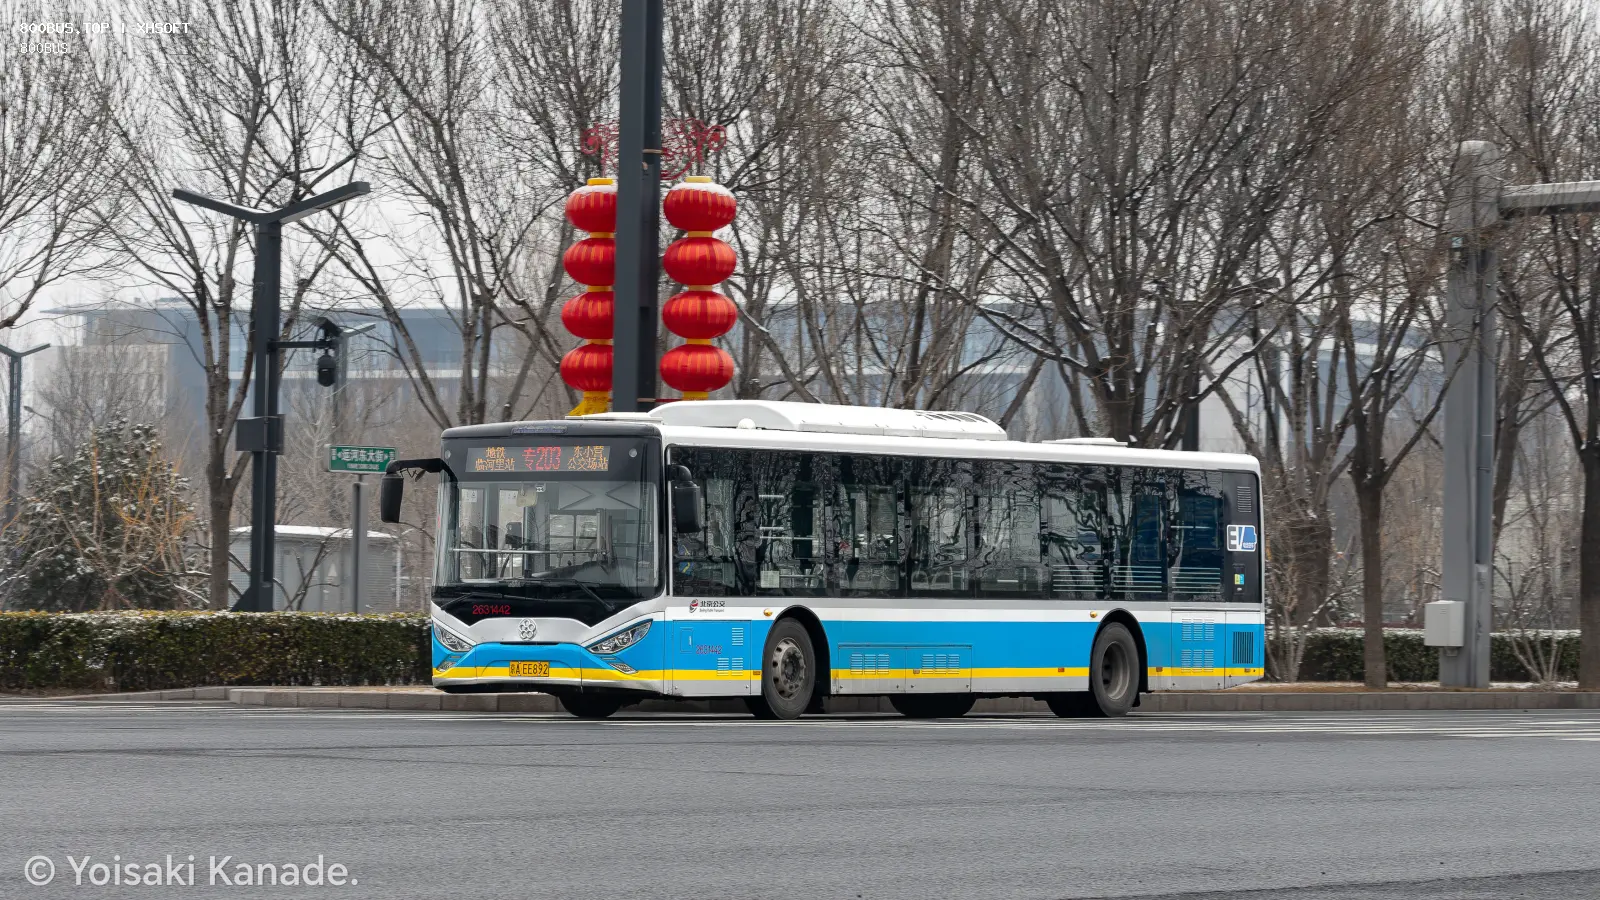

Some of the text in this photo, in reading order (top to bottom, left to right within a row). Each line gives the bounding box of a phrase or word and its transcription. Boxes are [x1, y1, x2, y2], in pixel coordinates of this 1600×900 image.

[341, 448, 384, 463] 运河东大街
[485, 446, 506, 459] 地铁
[573, 445, 604, 458] 东小营
[475, 458, 516, 471] 临河里站
[521, 446, 562, 471] 专203
[567, 457, 609, 471] 公交场站
[471, 604, 511, 615] 2631442
[699, 600, 726, 608] 北京公交
